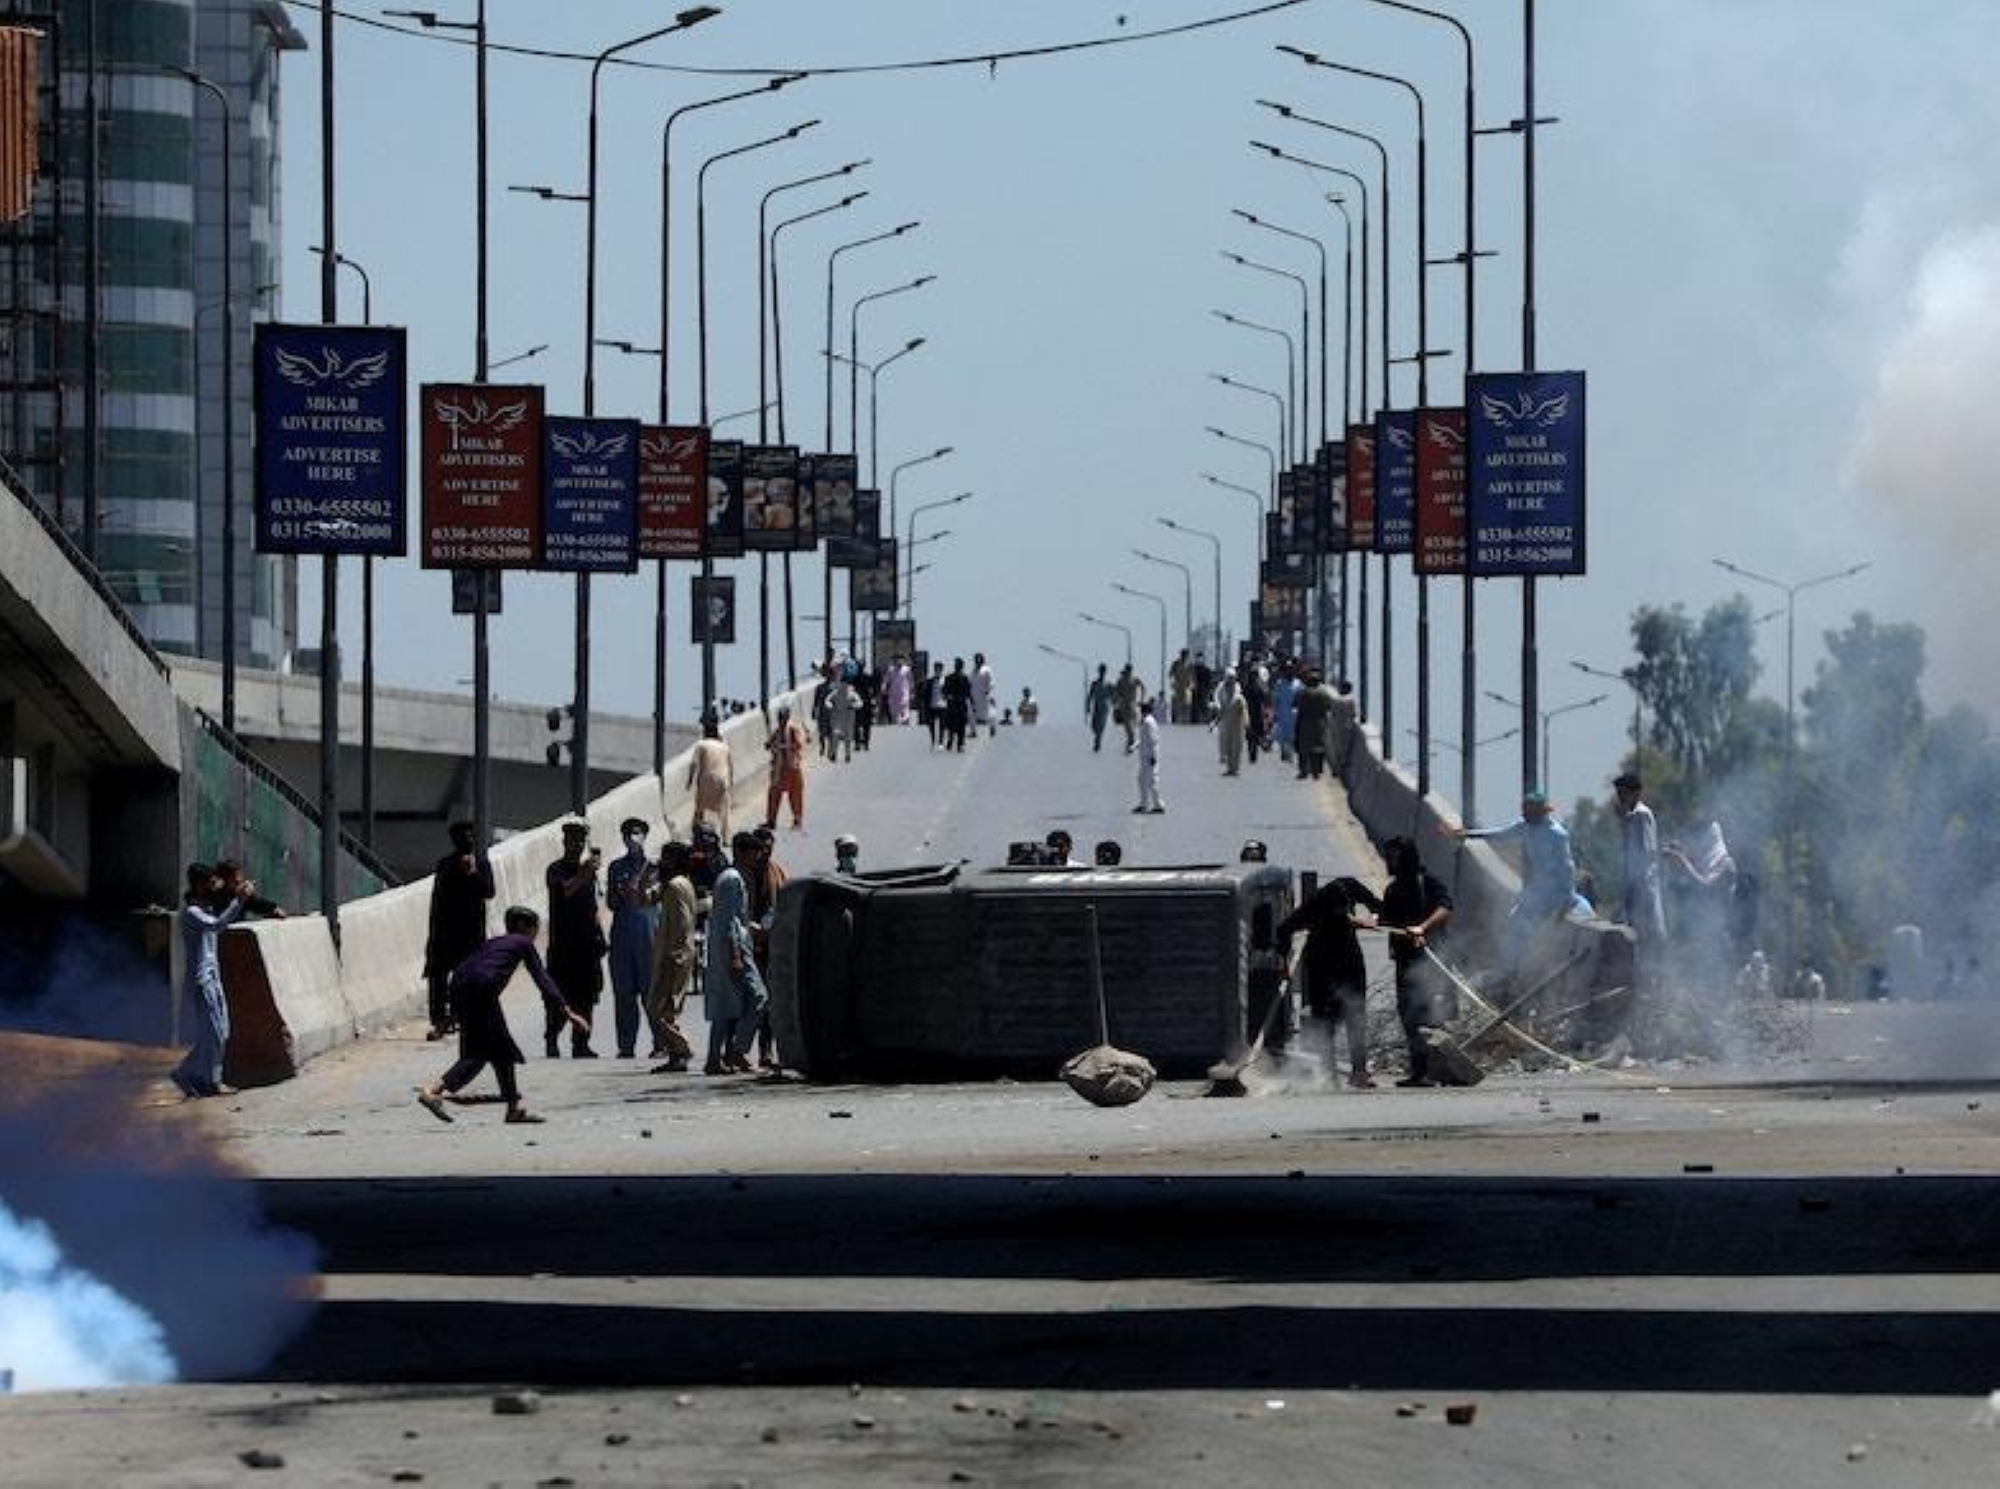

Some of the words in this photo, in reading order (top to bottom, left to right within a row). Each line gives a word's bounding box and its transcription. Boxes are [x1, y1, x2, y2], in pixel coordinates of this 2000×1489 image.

[281, 416, 385, 432] ADVERTISERS
[283, 447, 381, 463] ADVERTISE
[441, 454, 525, 466] ADVERTISERS
[1487, 452, 1567, 466] ADVERTISERS
[307, 466, 356, 481] HERE
[444, 480, 519, 491] ADVERTISE
[1488, 481, 1564, 494] ADVERTISE
[462, 494, 500, 506] HERE
[555, 499, 620, 510] ADVERTISE
[1507, 498, 1545, 510] HERE
[271, 499, 391, 516] 0330-6555502
